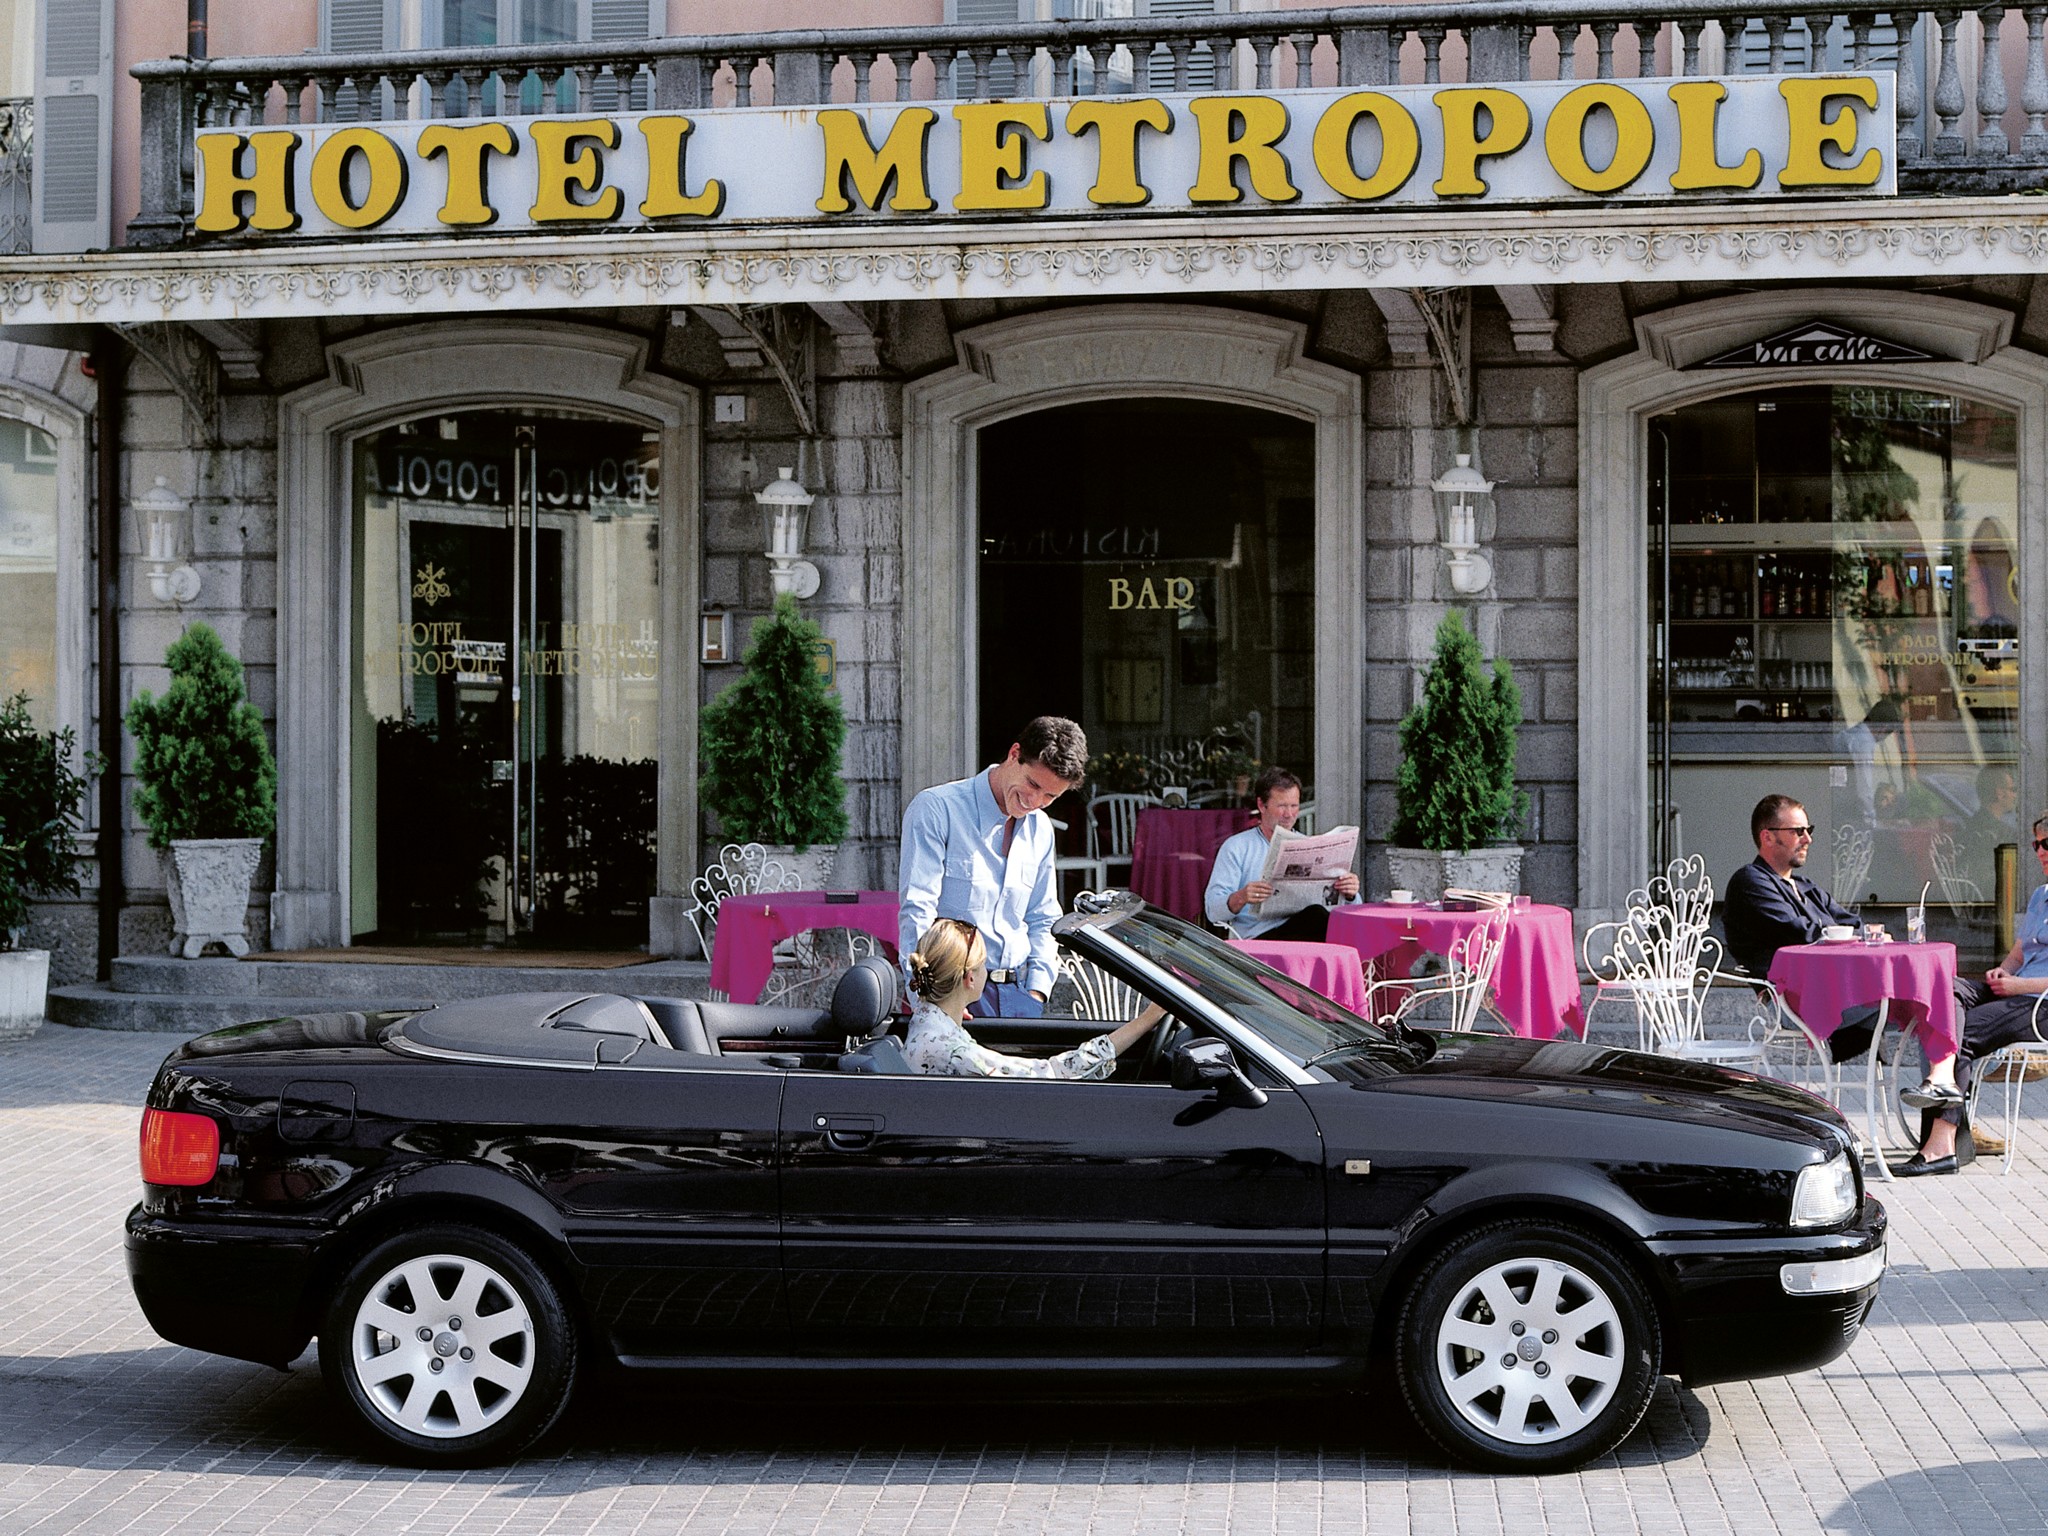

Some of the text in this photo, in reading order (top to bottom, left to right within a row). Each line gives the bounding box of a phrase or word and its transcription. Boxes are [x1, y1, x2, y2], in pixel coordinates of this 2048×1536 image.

[195, 76, 1884, 233] HOTEL METROPOLE
[1755, 342, 1802, 363] bar
[727, 402, 733, 415] 1
[1108, 577, 1196, 610] BAR
[396, 622, 466, 647] HOTEL
[1903, 635, 1939, 649] BAR
[1872, 651, 1972, 667] ETROPOLE
